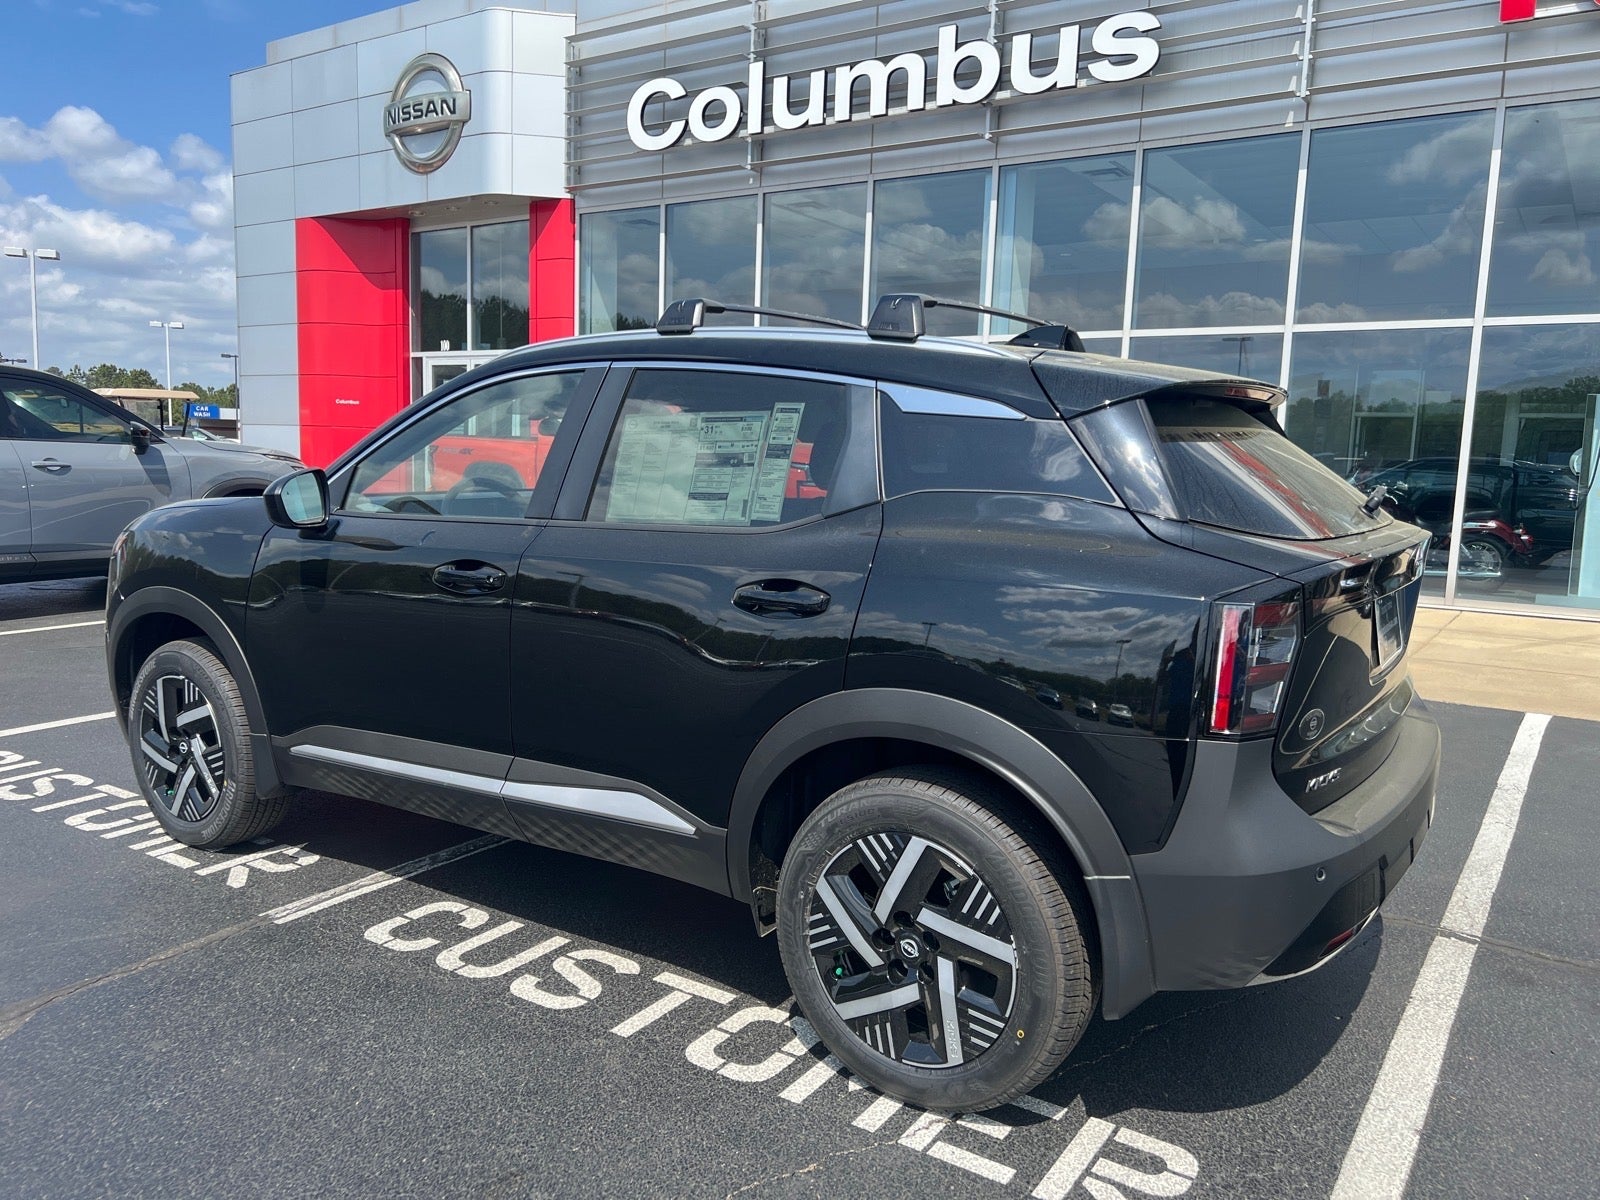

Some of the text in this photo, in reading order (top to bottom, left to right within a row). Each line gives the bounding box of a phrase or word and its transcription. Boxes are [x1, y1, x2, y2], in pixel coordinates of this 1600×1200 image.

[627, 11, 1161, 152] Columbus
[387, 98, 457, 126] NISSAN
[440, 339, 450, 352] 100
[704, 425, 714, 434] 31
